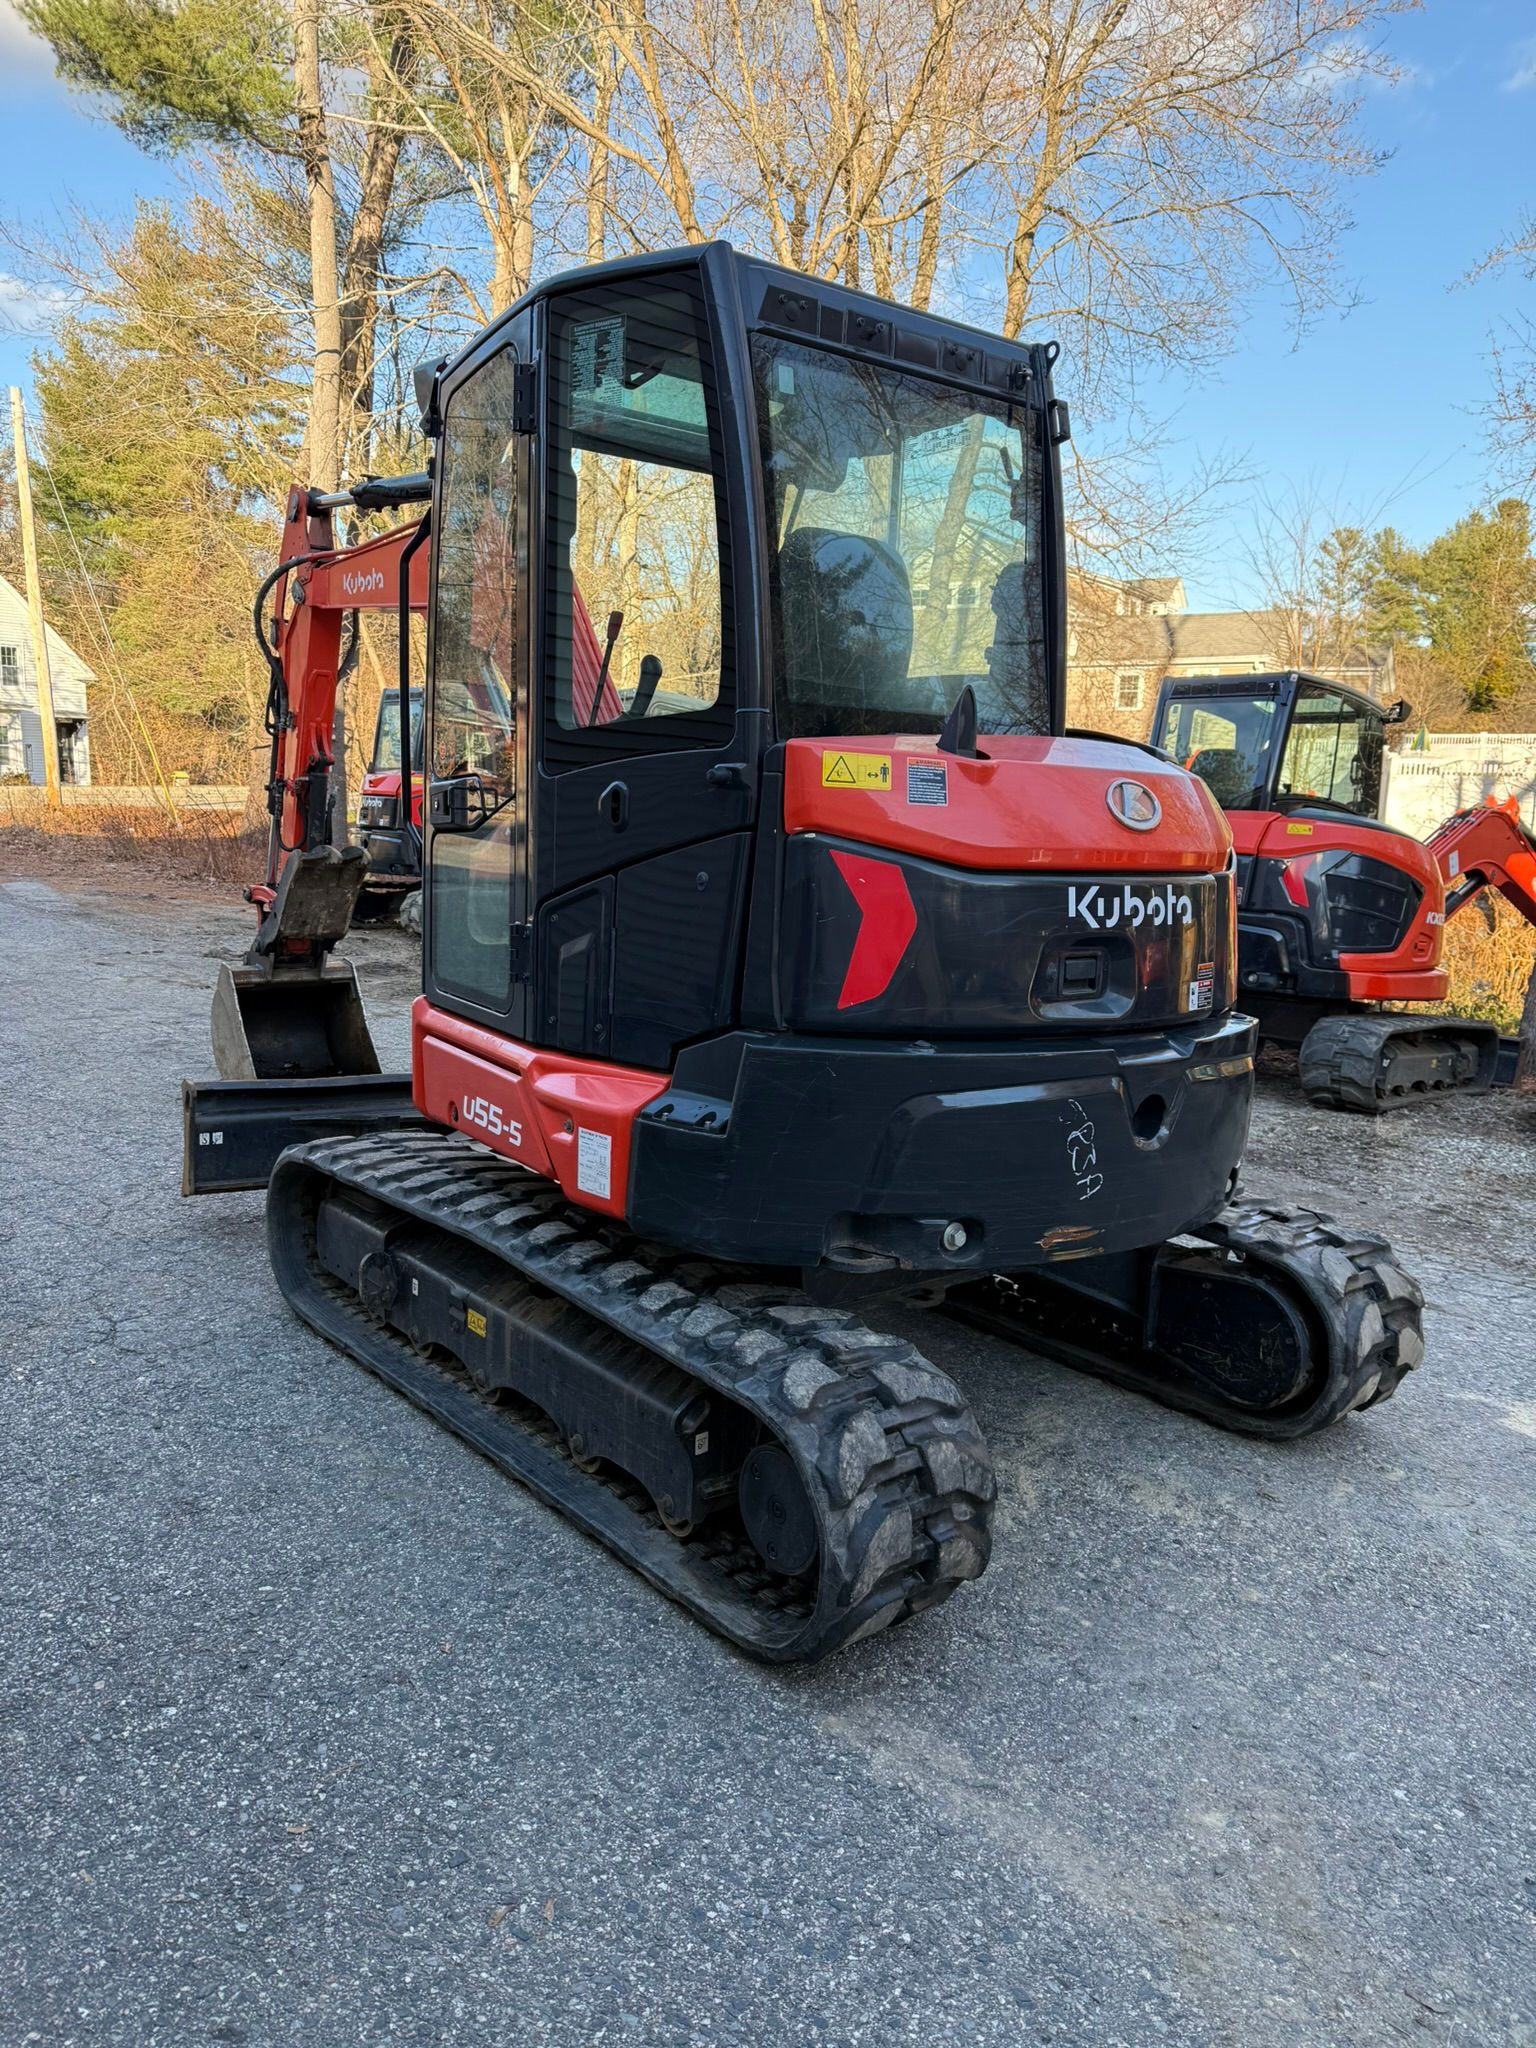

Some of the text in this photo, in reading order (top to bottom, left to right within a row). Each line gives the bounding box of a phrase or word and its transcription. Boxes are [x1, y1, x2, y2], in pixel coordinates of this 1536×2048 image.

[343, 568, 384, 595] Kubota
[1067, 884, 1193, 929] Kubota
[463, 1095, 522, 1147] U55-5
